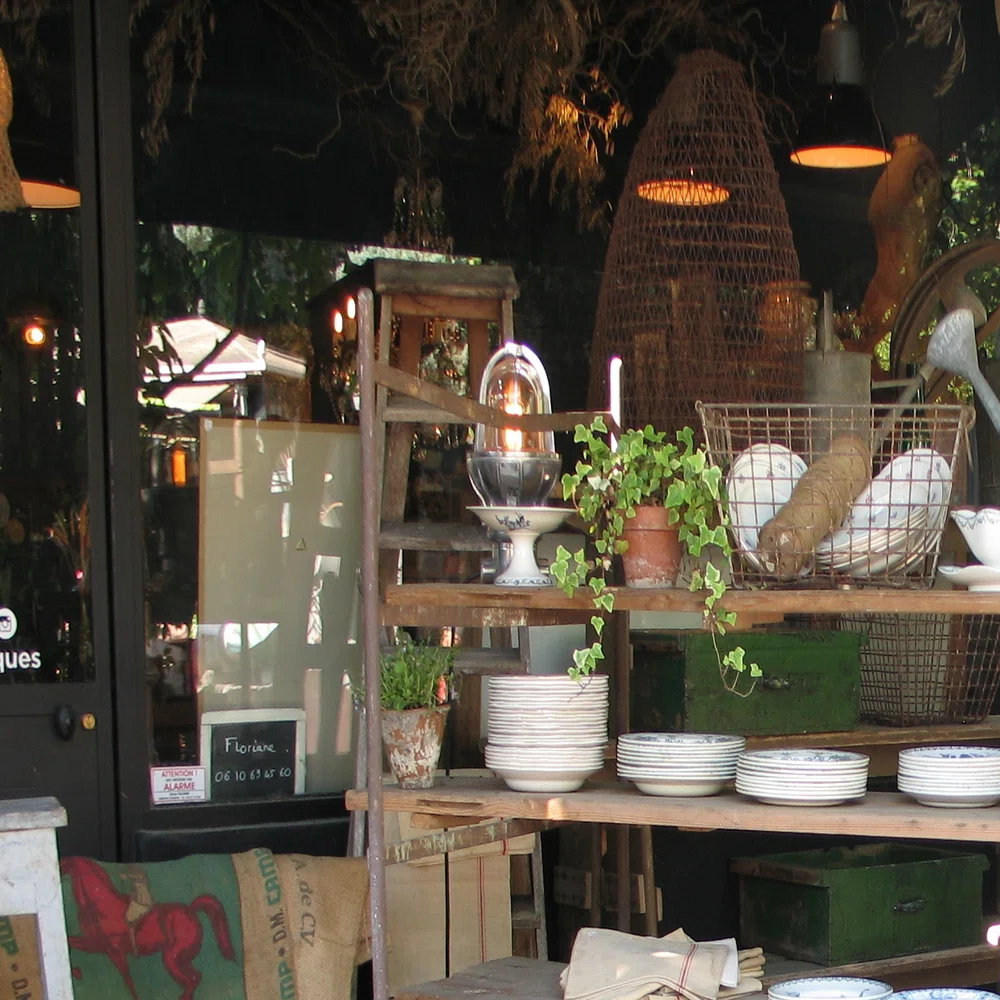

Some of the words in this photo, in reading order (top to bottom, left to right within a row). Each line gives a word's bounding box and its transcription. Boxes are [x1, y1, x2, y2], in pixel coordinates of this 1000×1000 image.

[225, 737, 276, 754] Floriane
[161, 770, 194, 778] ATTENTION
[214, 770, 231, 782] 06
[235, 770, 246, 781] 10
[264, 769, 275, 779] 45
[280, 767, 292, 777] 60
[163, 782, 196, 791] ALARME
